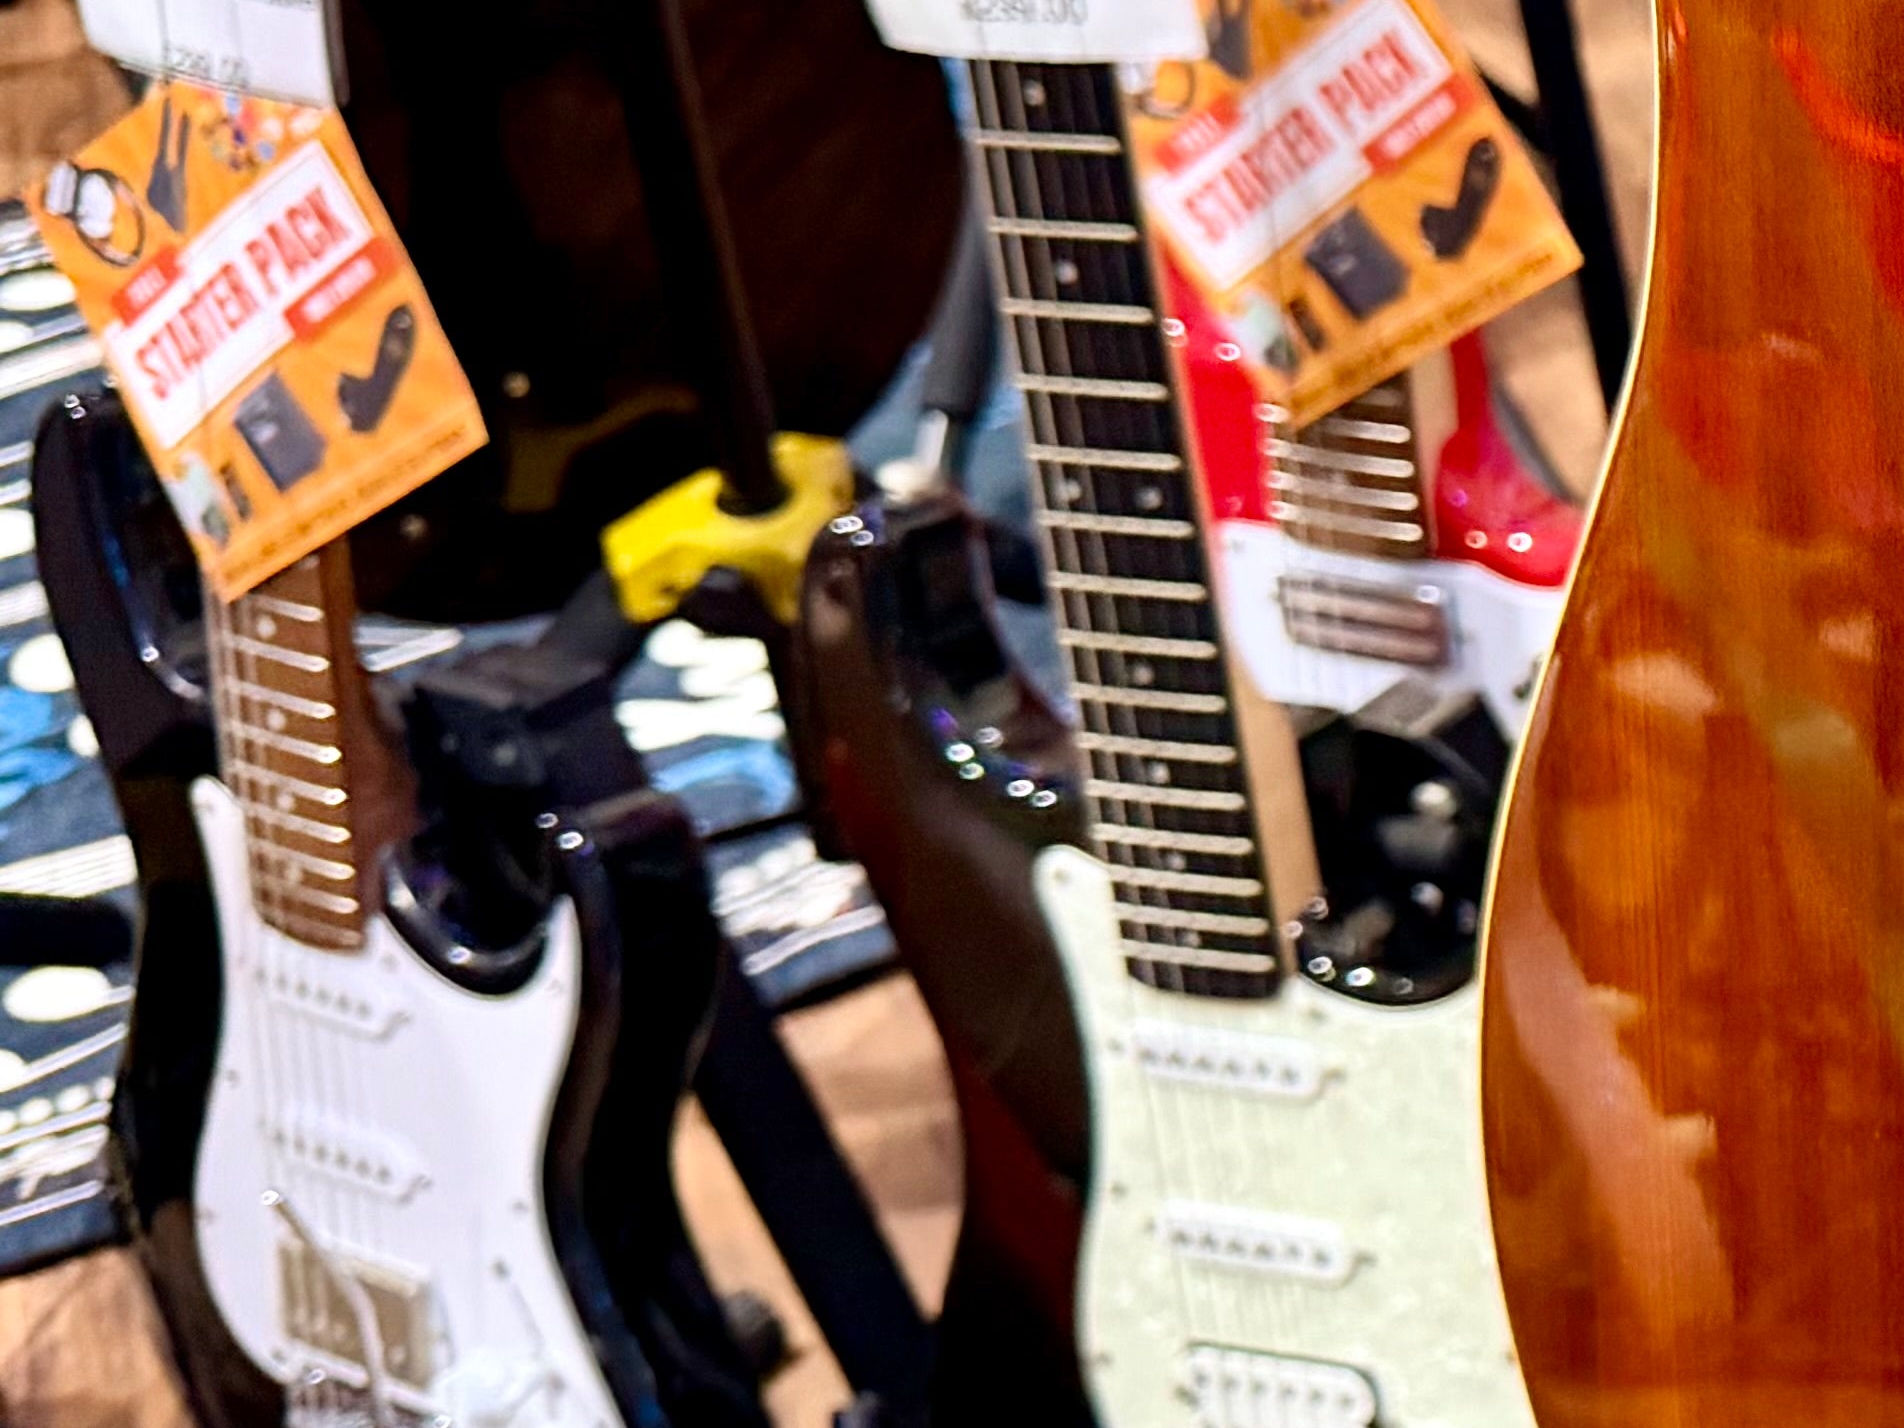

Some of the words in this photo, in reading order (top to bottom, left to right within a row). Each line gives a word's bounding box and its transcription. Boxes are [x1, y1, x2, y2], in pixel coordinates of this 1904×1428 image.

[1181, 103, 1336, 247] STARTER
[1315, 26, 1420, 130] PACK
[134, 261, 262, 401] STARTER
[245, 185, 353, 295] PACK
